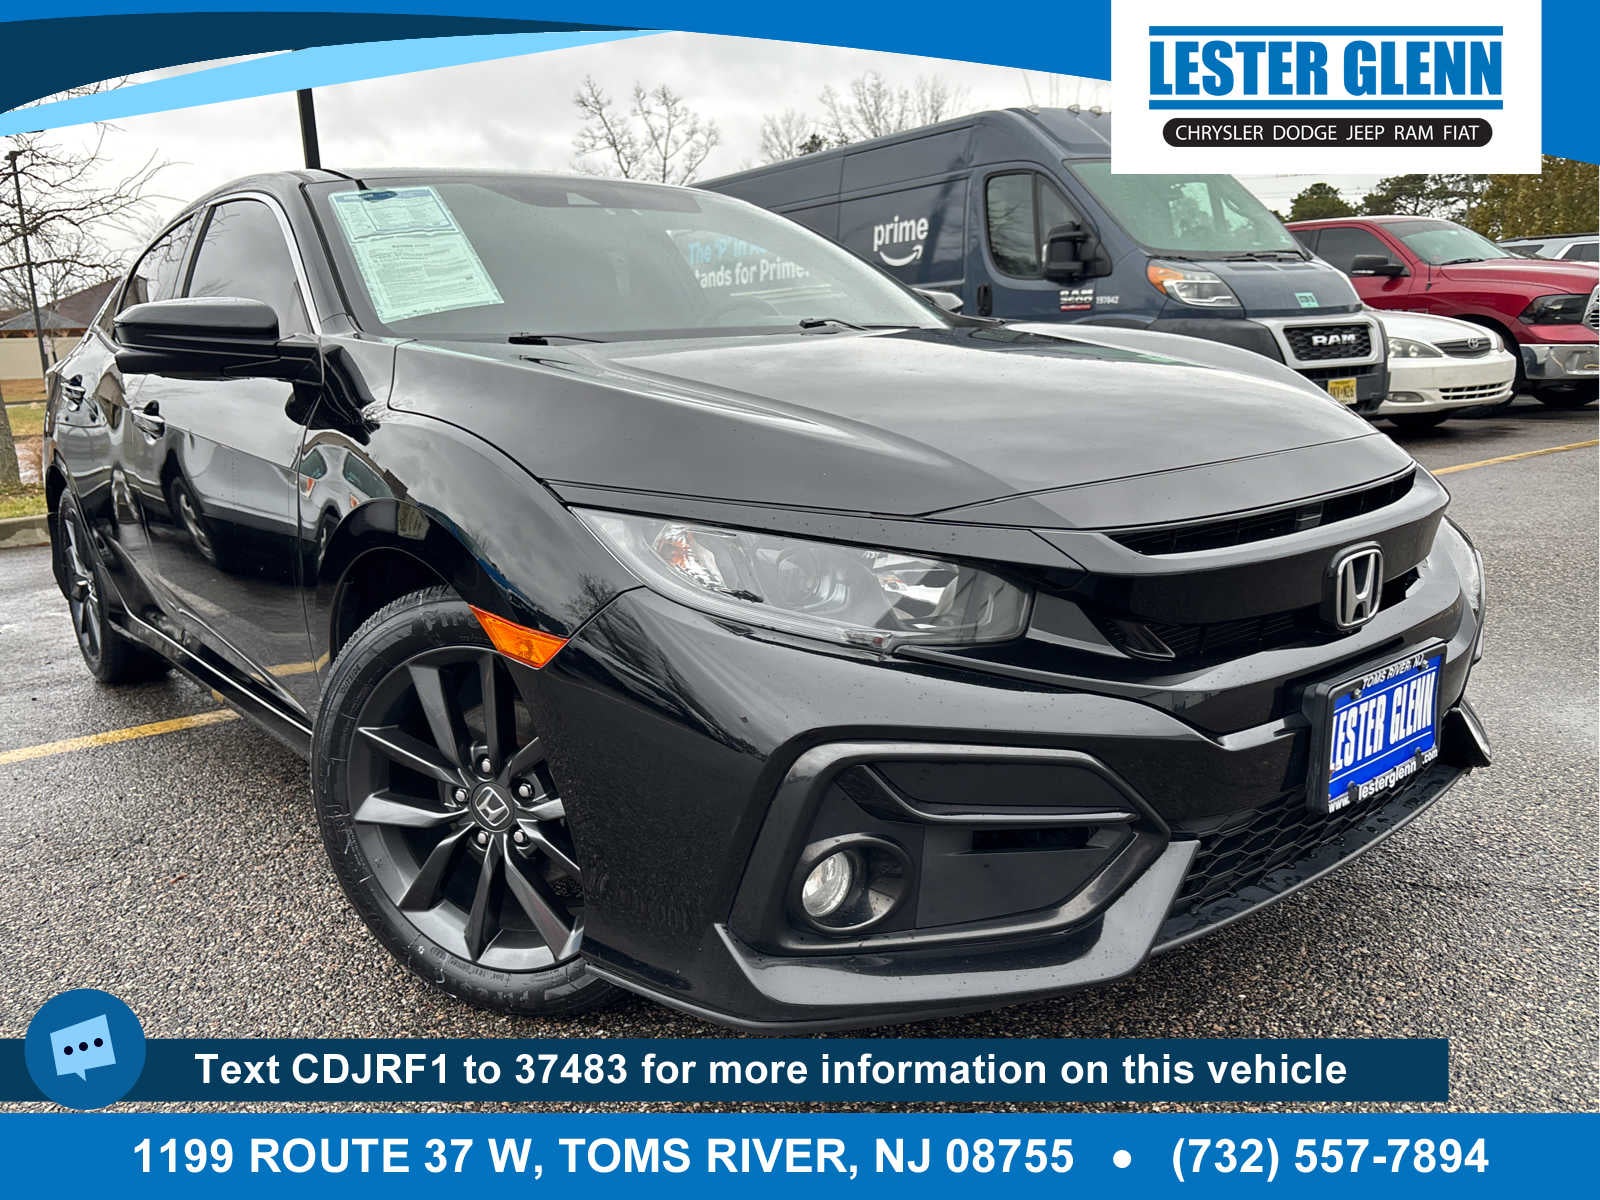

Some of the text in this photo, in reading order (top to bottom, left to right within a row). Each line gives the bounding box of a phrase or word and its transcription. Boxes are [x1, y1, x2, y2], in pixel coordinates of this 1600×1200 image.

[873, 215, 928, 250] prime
[688, 240, 712, 265] The
[735, 261, 758, 285] for
[1312, 333, 1356, 346] RAM
[1362, 669, 1387, 689] TOMS
[1414, 653, 1425, 668] NJ
[1329, 671, 1436, 771] LESTER GLENN
[1358, 760, 1417, 800] lesterglenn
